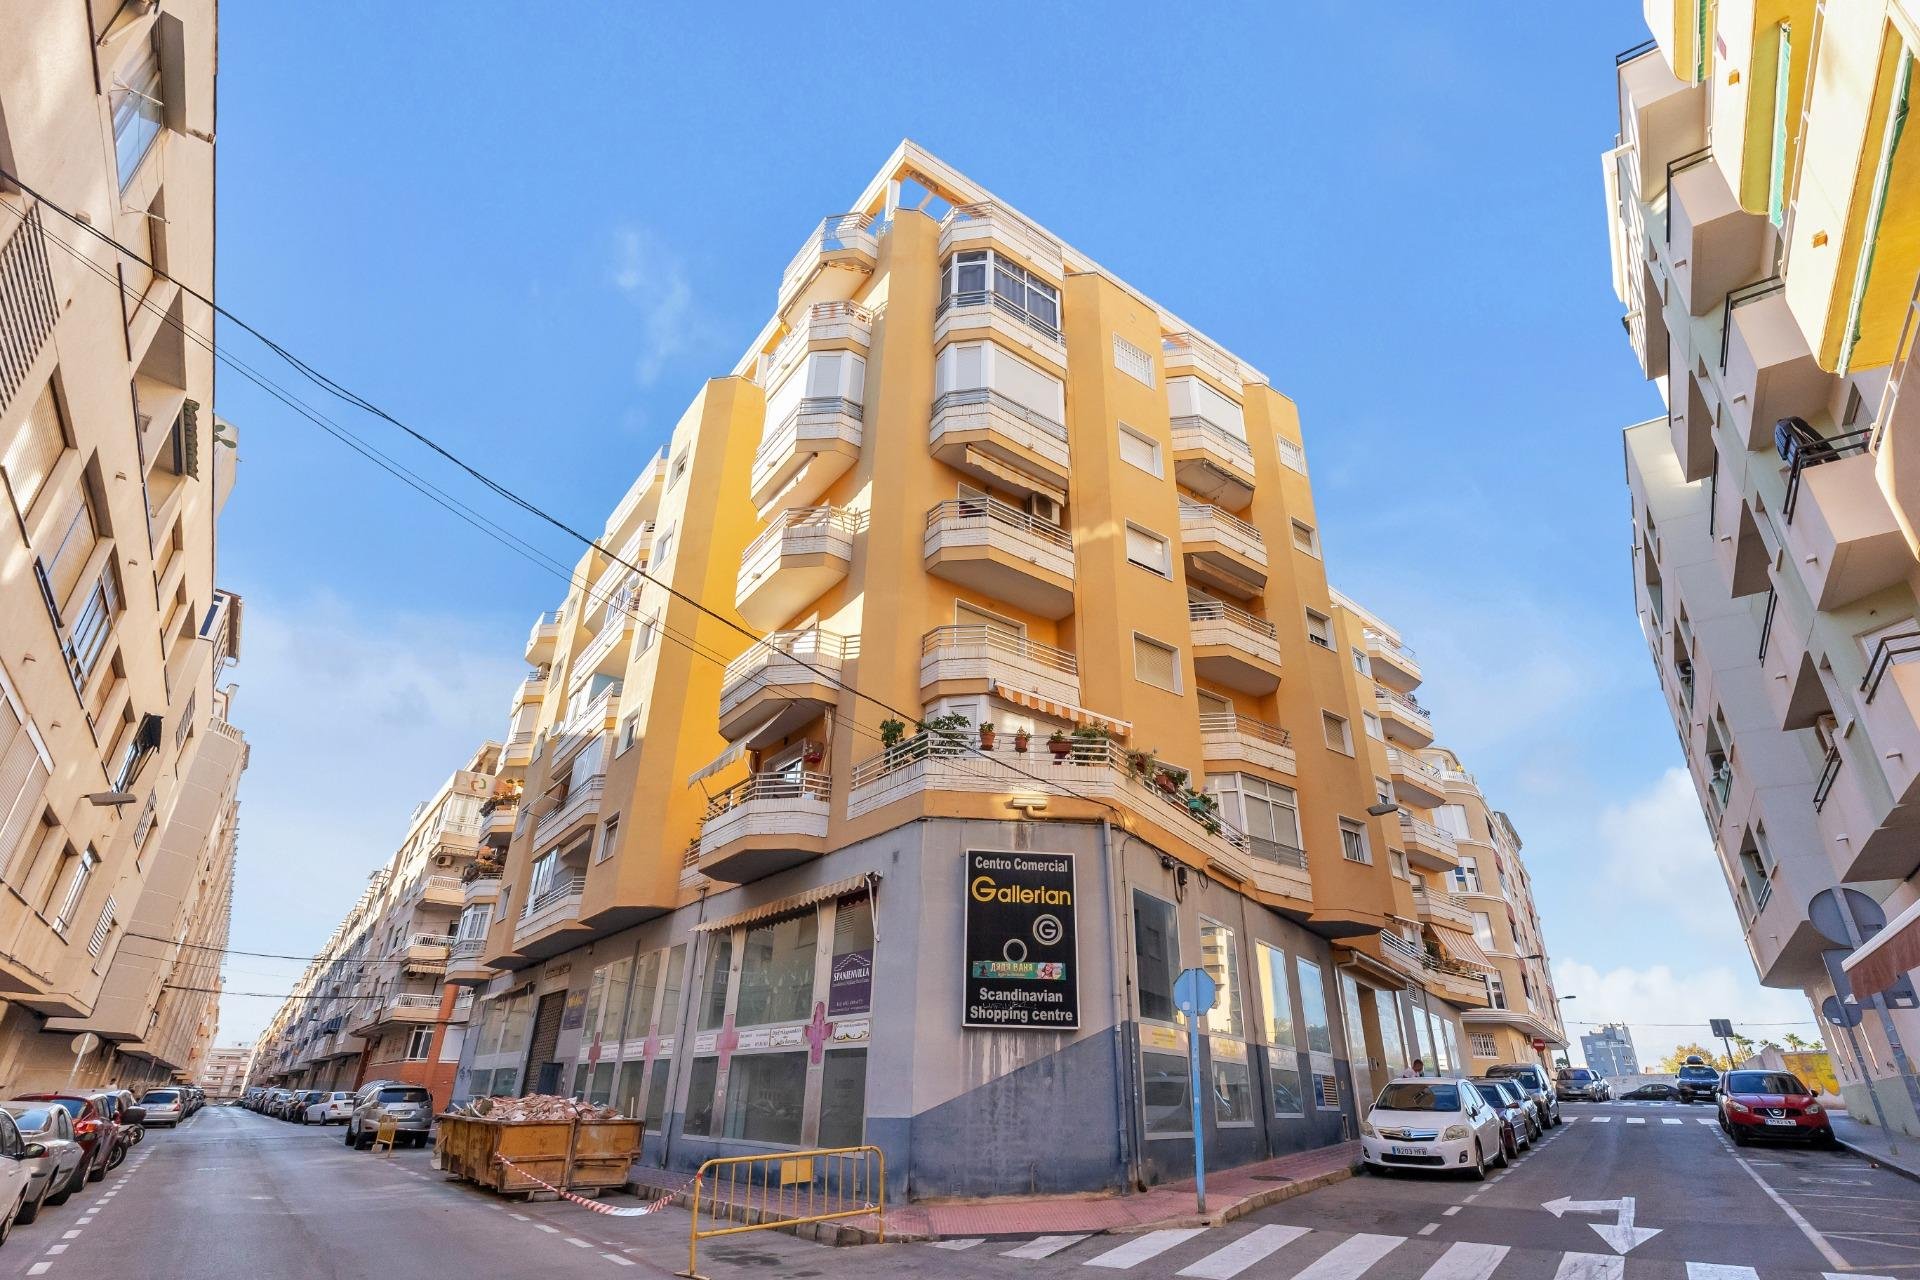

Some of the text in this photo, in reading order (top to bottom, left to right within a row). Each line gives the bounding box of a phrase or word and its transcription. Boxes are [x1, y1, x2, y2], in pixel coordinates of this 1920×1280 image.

[975, 855, 1068, 873] Centro Comercial
[971, 875, 1072, 906] Gallerian
[1038, 920, 1057, 939] G
[979, 987, 1063, 1003] Scandinavian
[970, 1005, 1028, 1024] Shopping
[1032, 1008, 1073, 1021] centre
